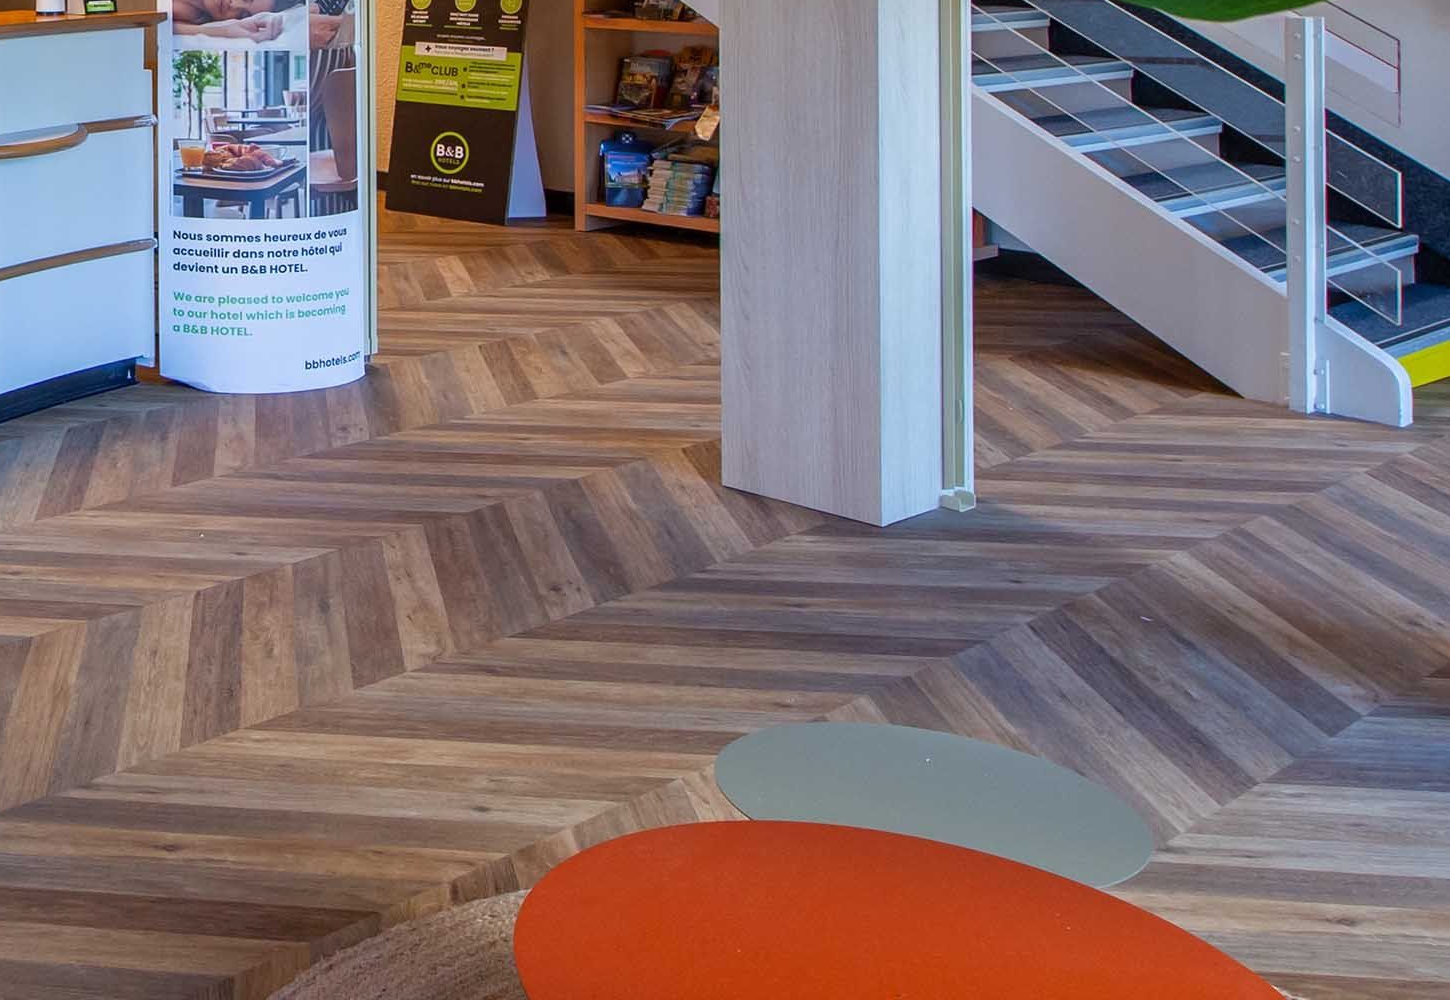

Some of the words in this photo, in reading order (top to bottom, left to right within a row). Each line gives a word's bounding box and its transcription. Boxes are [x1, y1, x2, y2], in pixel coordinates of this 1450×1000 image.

[431, 65, 459, 77] CLUB
[435, 143, 464, 159] B&B
[172, 229, 203, 241] Nous
[206, 232, 261, 243] sommes
[263, 229, 312, 243] heureux
[313, 229, 327, 241] de
[327, 226, 347, 238] vous
[172, 245, 231, 258] accueillir
[232, 246, 264, 258] dans
[266, 247, 299, 258] notre
[301, 244, 328, 257] hôtel
[328, 242, 343, 257] qui
[172, 261, 219, 274] devient
[221, 264, 238, 275] un
[241, 263, 267, 275] B&B
[269, 263, 308, 275] HOTEL.
[173, 290, 192, 302] We
[194, 293, 215, 305] are
[217, 293, 269, 307] pleased
[271, 295, 283, 305] to
[285, 290, 334, 304] welcome
[334, 287, 350, 300] you
[173, 307, 185, 318] to
[187, 309, 208, 320] our
[210, 308, 243, 321] hotel
[245, 309, 283, 321] which
[285, 308, 295, 320] is
[297, 303, 347, 319] becoming
[172, 325, 181, 334] a
[183, 324, 208, 335] B&B
[210, 325, 254, 337] HOTEL.
[304, 350, 361, 371] bbhotels.com
